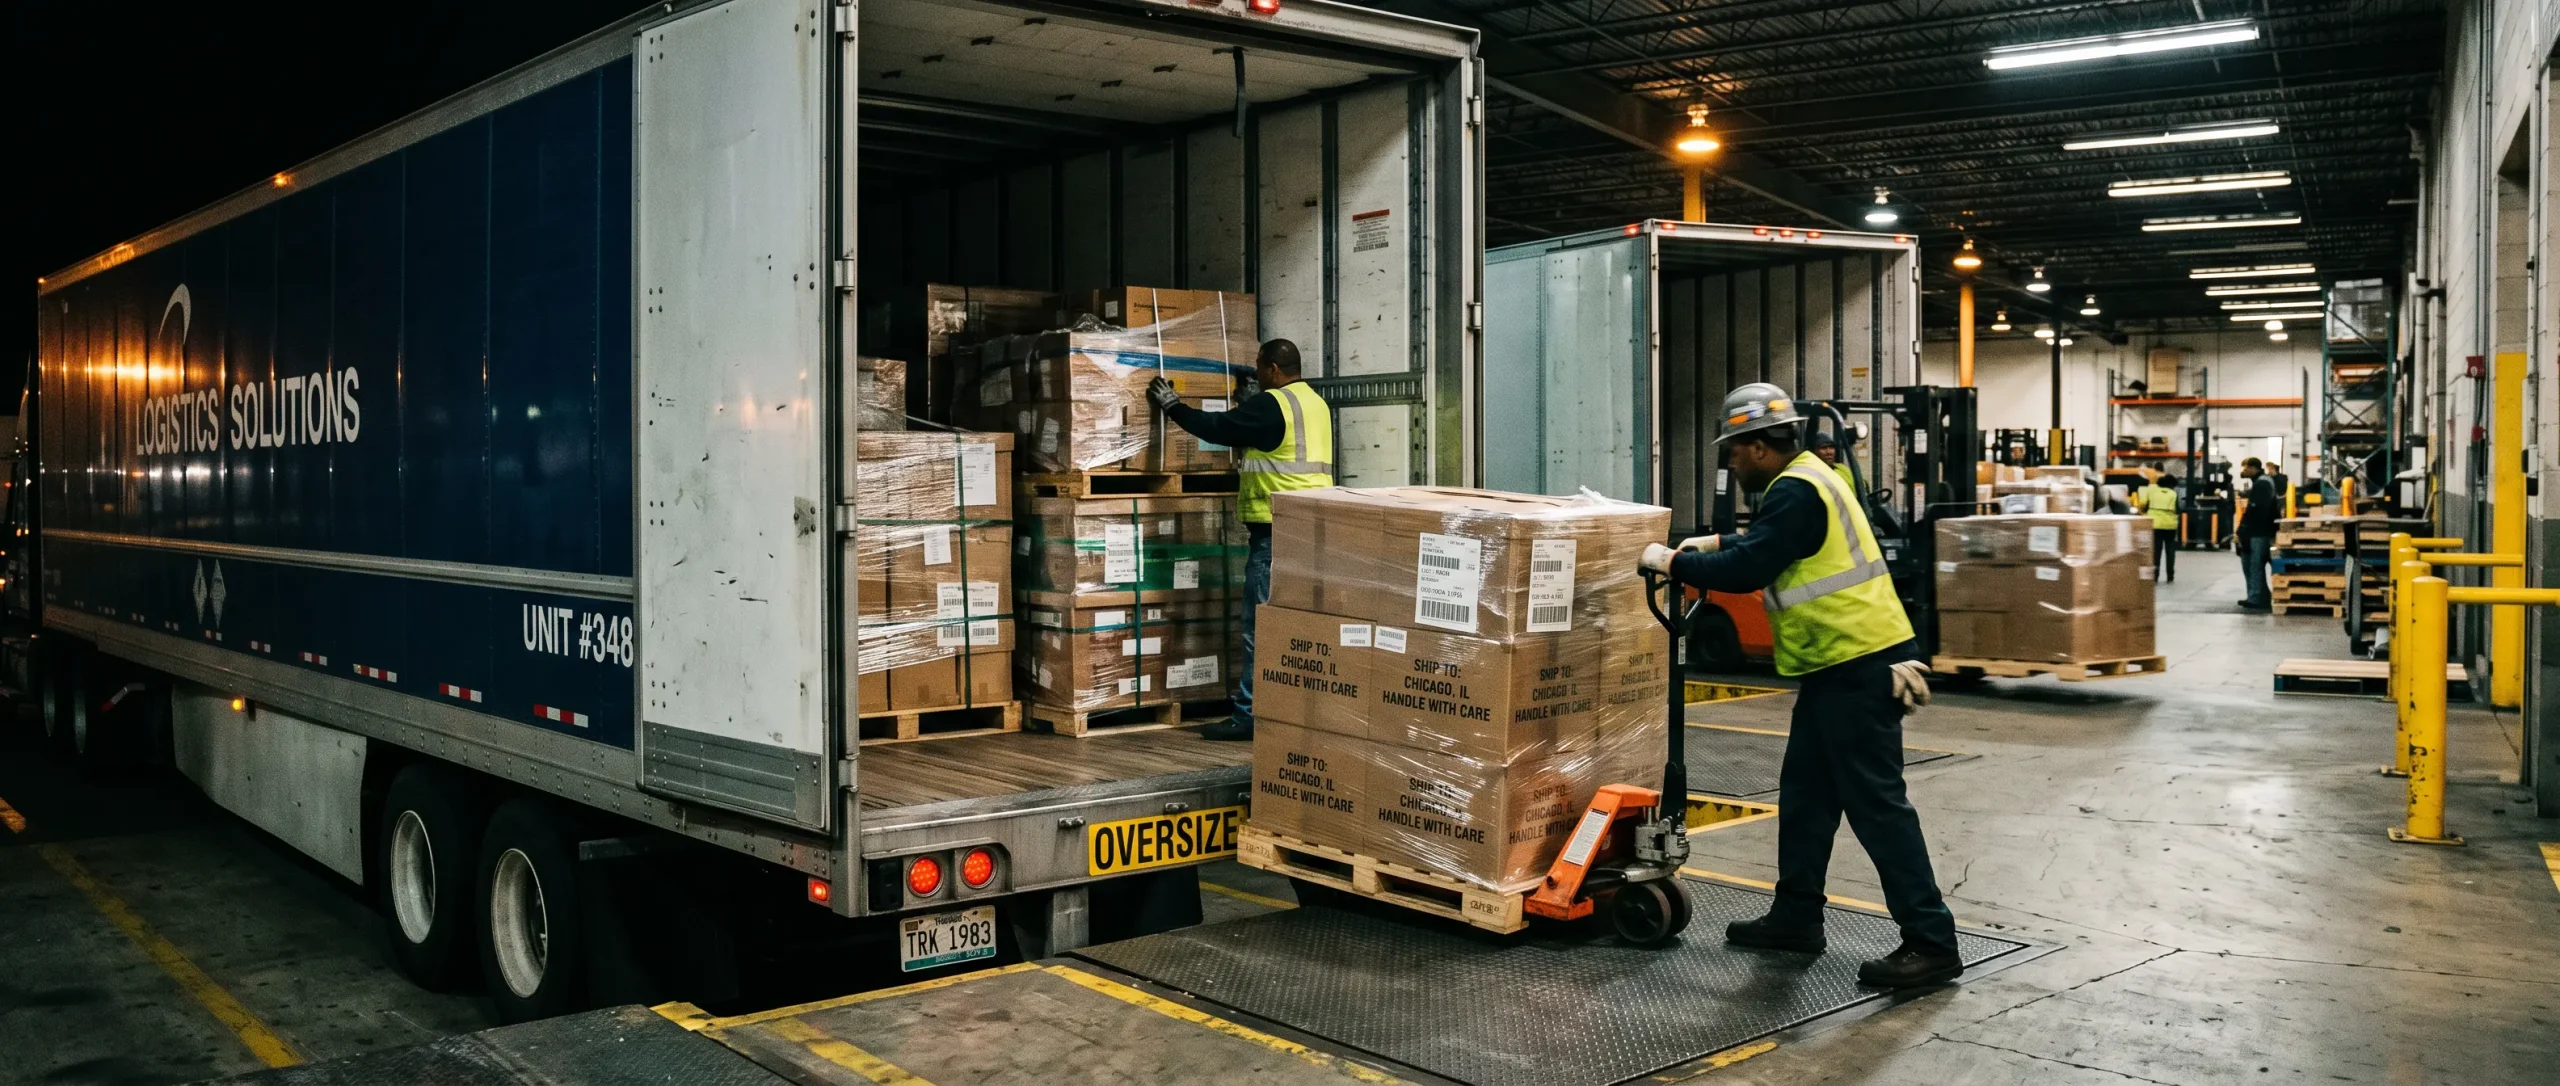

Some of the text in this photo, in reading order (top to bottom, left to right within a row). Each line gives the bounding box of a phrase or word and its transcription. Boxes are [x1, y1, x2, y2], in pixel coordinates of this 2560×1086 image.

[136, 366, 360, 456] LOGISTICS SOLUTIONS
[523, 603, 634, 668] UNIT #348
[1290, 638, 1332, 657] SHIP TO:
[1281, 654, 1339, 676] CHICAGO, IL
[1414, 659, 1462, 679] SHIP TO:
[1262, 668, 1358, 699] HANDLE WITH CARE
[1404, 675, 1470, 700] CHICAGO, IL
[1382, 690, 1491, 722] HANDLE WITH CARE
[1514, 705, 1549, 723] HANDLE
[1550, 702, 1570, 718] WITH
[1287, 752, 1328, 772] SHIP TO:
[1278, 767, 1335, 792] CHICAGO, IL
[1409, 777, 1435, 795] SHIP
[1260, 780, 1354, 814] HANDLE WITH CARE
[1533, 787, 1553, 802] SHIP
[1378, 807, 1485, 844] HANDLE WITH CARE
[1509, 825, 1543, 844] HANDLE
[1545, 820, 1565, 837] WITH
[1094, 810, 1238, 870] OVERSIZE
[906, 928, 939, 958] TRK
[949, 920, 991, 951] 1983
